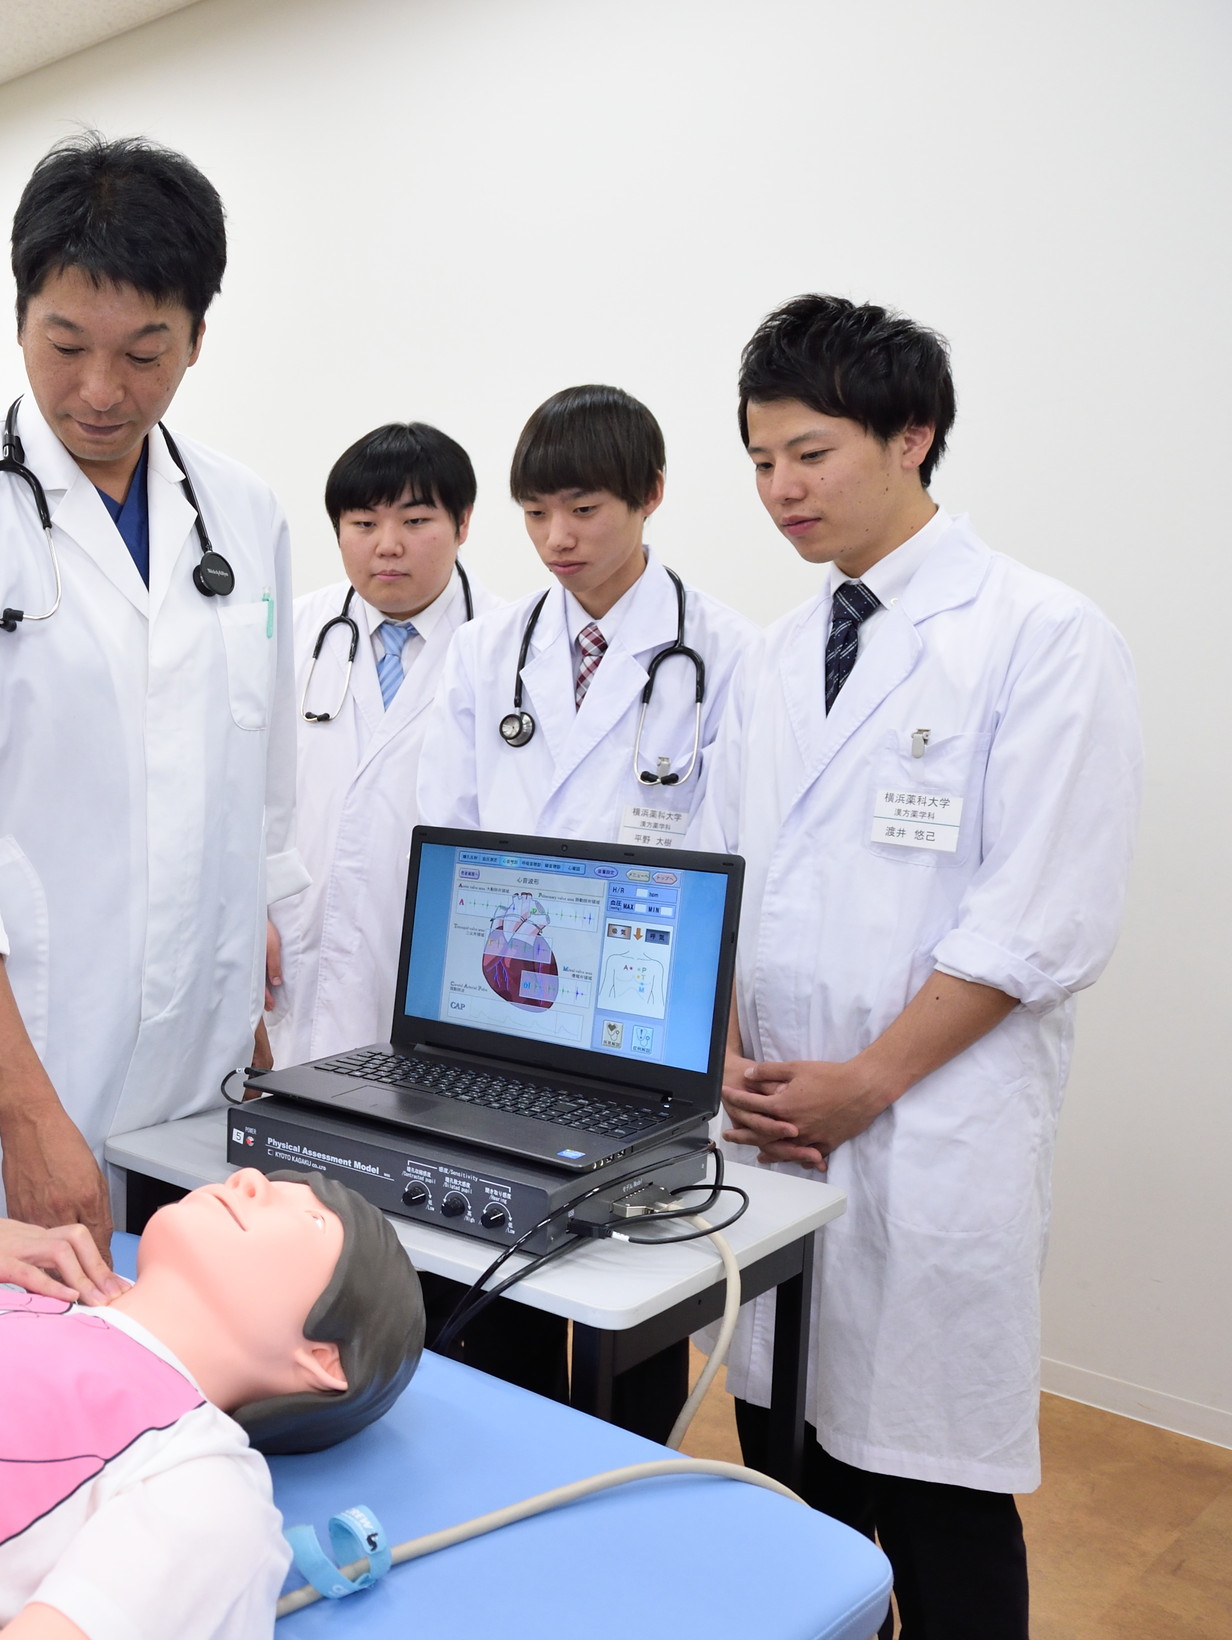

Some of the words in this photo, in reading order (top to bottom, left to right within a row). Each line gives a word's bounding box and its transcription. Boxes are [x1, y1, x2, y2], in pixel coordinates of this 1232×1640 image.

[885, 792, 951, 809] 横浜薬科大学
[632, 807, 682, 821] 横浜薬科大学
[894, 808, 935, 820] 漢方薬学科
[640, 820, 671, 831] 漢方薬学科
[885, 826, 906, 838] 渡井
[634, 834, 651, 844] 平野
[516, 876, 540, 885] 心音波形
[612, 886, 625, 894] H/R
[450, 1001, 466, 1010] CAP
[236, 1131, 242, 1141] 5
[244, 1126, 257, 1135] POWER
[267, 1136, 301, 1152] Physical
[302, 1146, 352, 1167] Assessment
[353, 1160, 380, 1175] Model
[274, 1151, 292, 1161] KYOTO
[292, 1155, 312, 1167] KAGAKU
